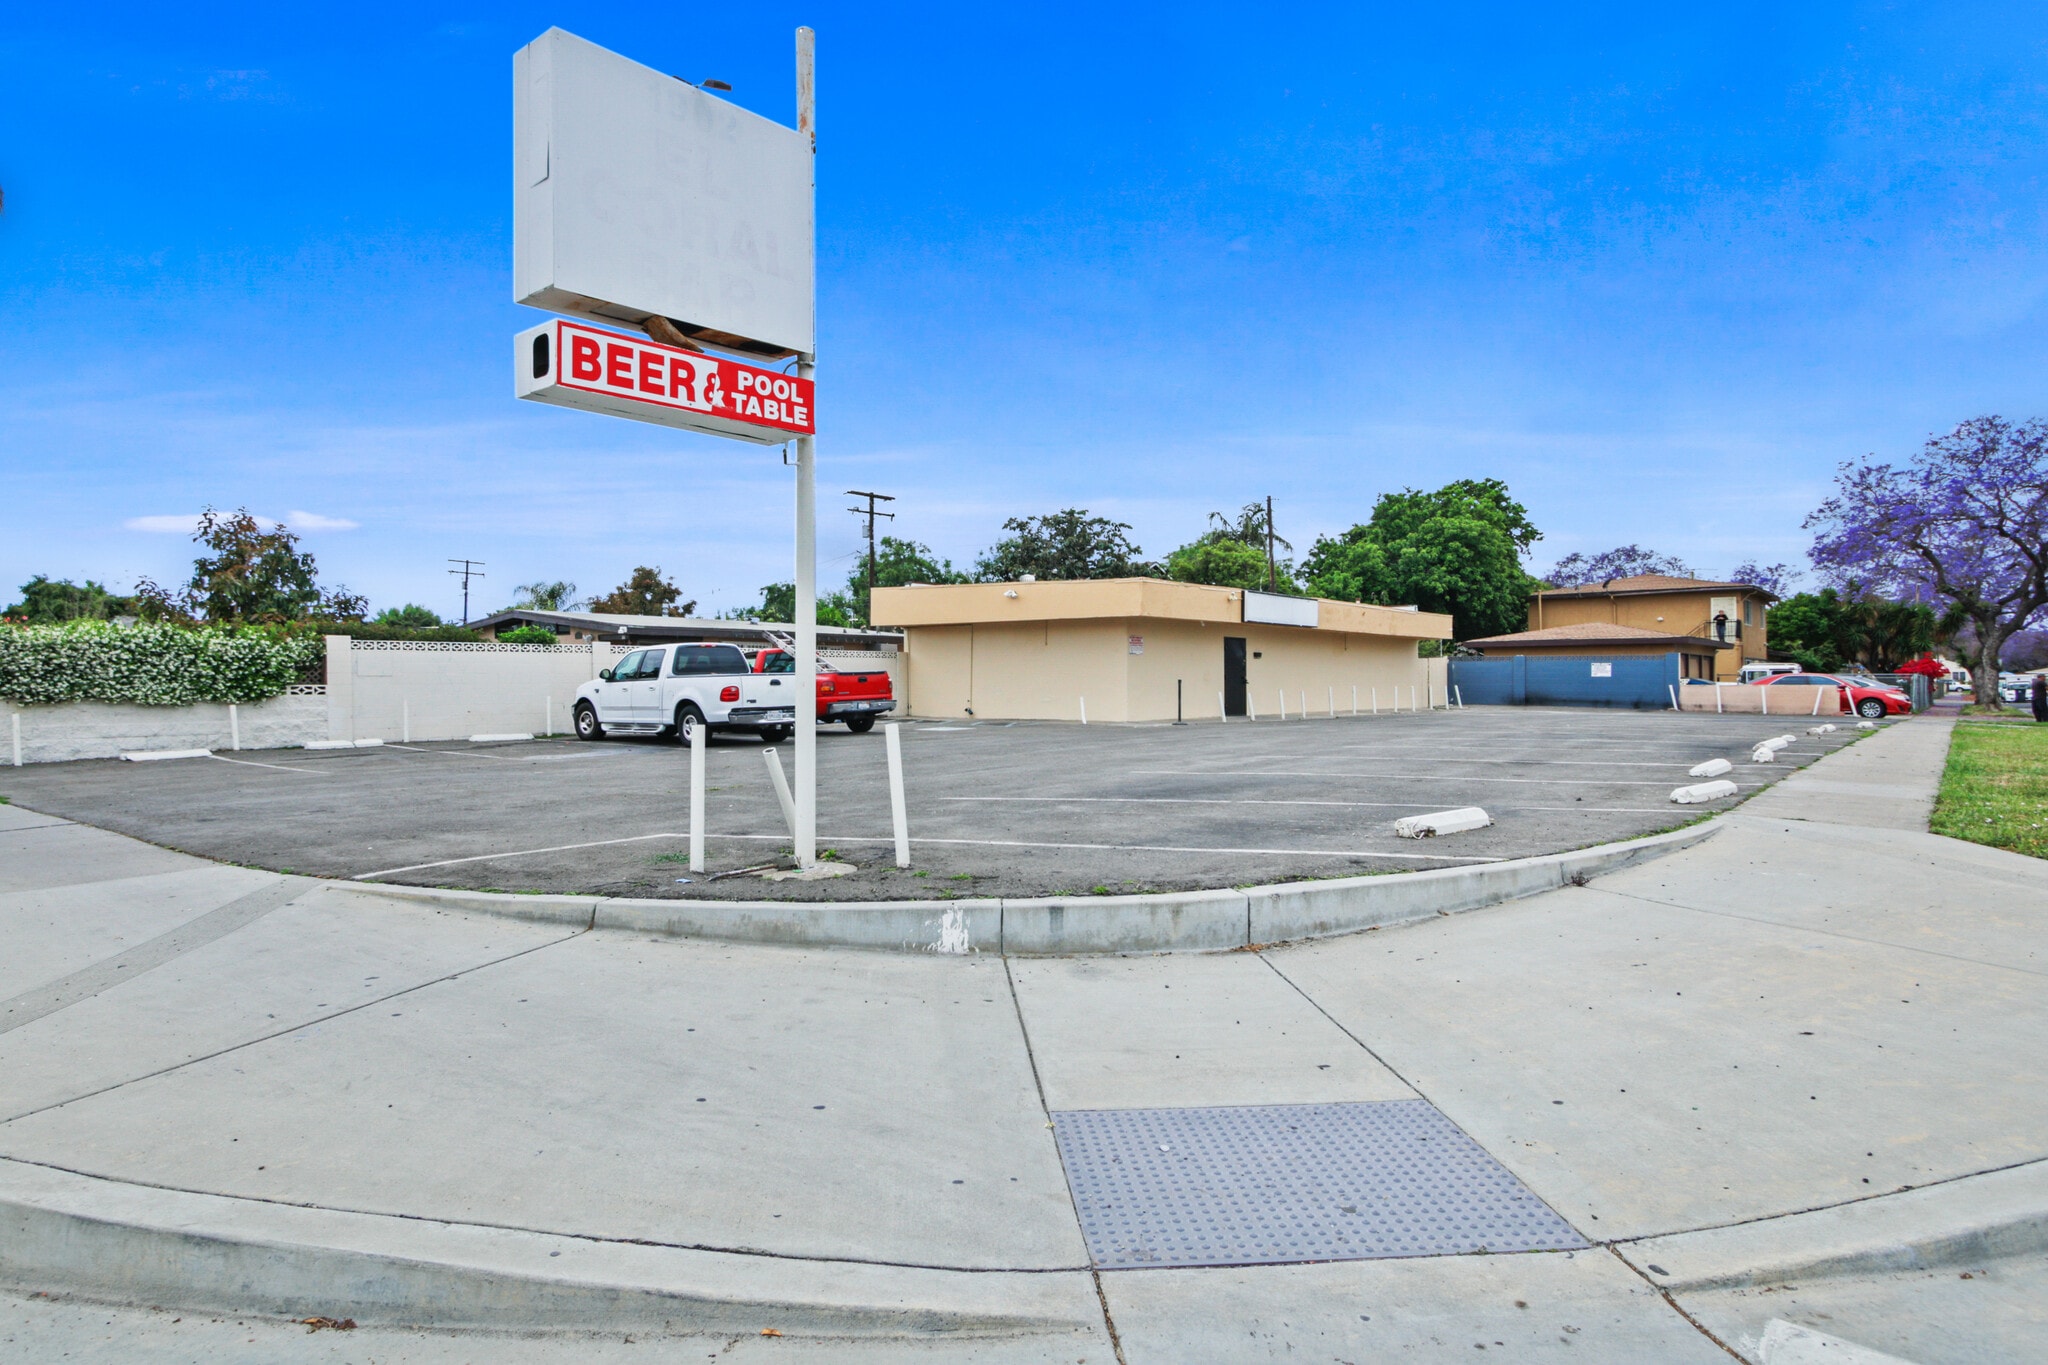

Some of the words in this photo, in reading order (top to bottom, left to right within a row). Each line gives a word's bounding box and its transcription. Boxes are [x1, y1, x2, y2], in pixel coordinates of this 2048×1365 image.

[572, 335, 696, 402] BEER
[703, 372, 725, 408] &
[737, 370, 803, 404] POOL
[731, 392, 809, 427] TABLE
